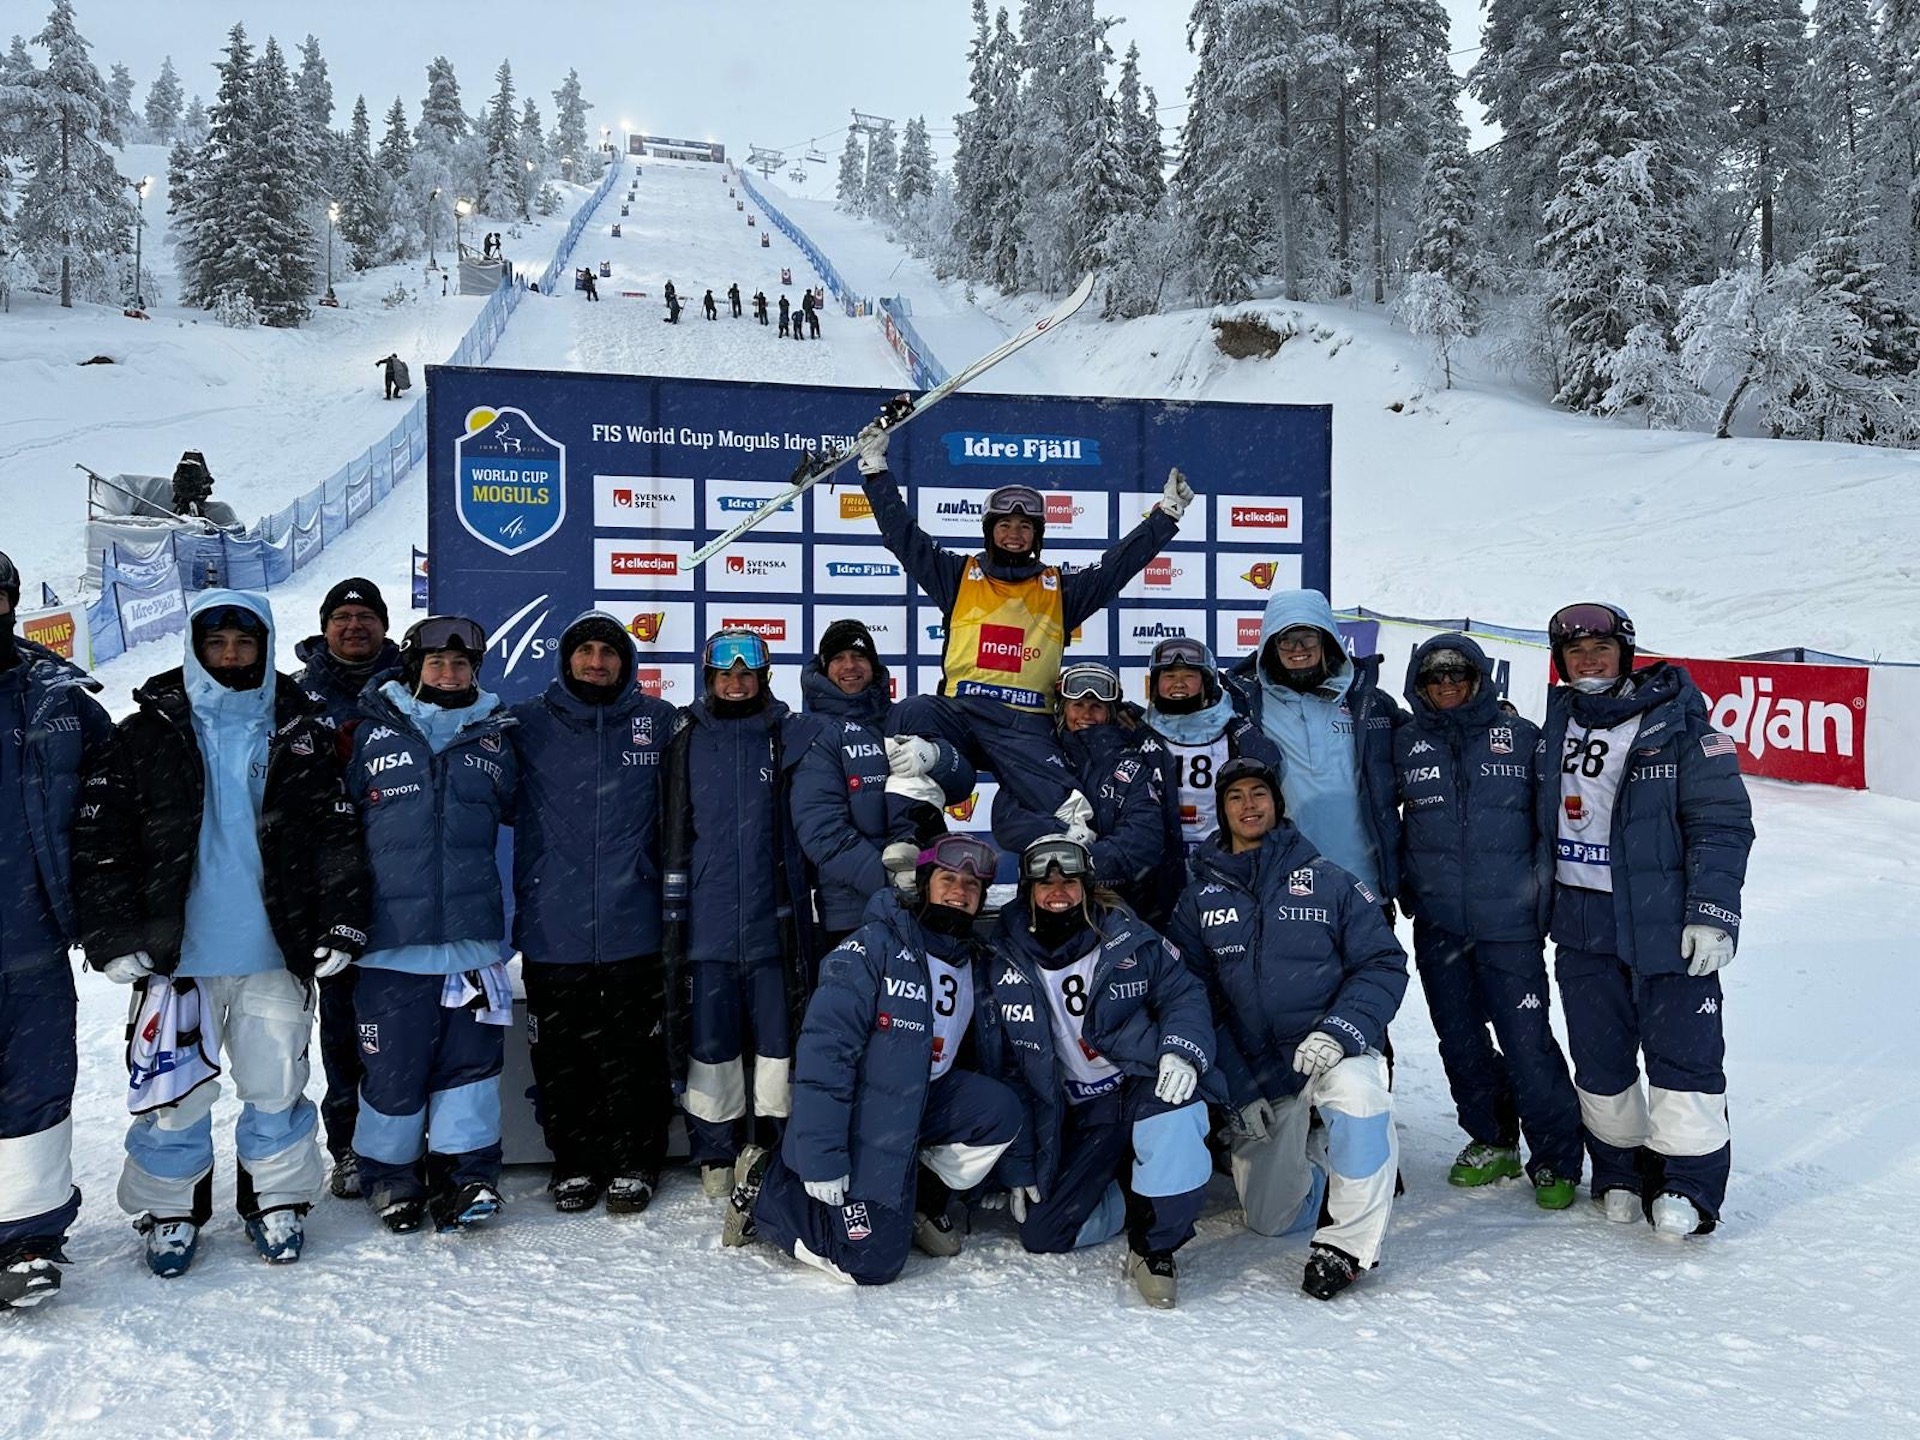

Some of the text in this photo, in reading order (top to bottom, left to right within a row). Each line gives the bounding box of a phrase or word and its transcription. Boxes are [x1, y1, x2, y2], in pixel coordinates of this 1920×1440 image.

[592, 424, 622, 443] FIS
[626, 425, 675, 446] World
[679, 428, 713, 450] Cup
[718, 430, 780, 452] Moguls
[784, 435, 816, 451] Idre
[964, 437, 1082, 463] Idre Fjäll
[472, 468, 549, 483] WORLD CUP
[472, 485, 549, 505] MOGULS
[634, 493, 676, 502] SVENSKA
[634, 501, 657, 509] SPEL
[728, 498, 756, 509] Idre
[1047, 506, 1085, 516] menigo
[1244, 511, 1287, 523] elkedjan
[626, 557, 675, 570] elkedjan
[746, 560, 787, 568] SVENSKA
[836, 564, 892, 576] Idre Fjäll
[1146, 566, 1183, 577] menigo
[1132, 623, 1186, 638] LAVAZZA
[1239, 629, 1261, 637] men
[982, 641, 1041, 662] menigo
[1001, 688, 1038, 705] Fjäll
[842, 744, 884, 760] VISA
[1562, 738, 1609, 778] 28
[365, 751, 414, 777] VISA
[1480, 763, 1528, 779] STIFEL
[1404, 766, 1441, 785] VISA
[382, 783, 421, 798] TOYOTA
[1278, 905, 1331, 925] STIFEL
[884, 977, 927, 1002] VISA
[935, 974, 959, 1017] 3
[1061, 974, 1088, 1017] 8
[892, 1017, 925, 1033] TOYOTA
[1076, 1081, 1114, 1096] Idre
